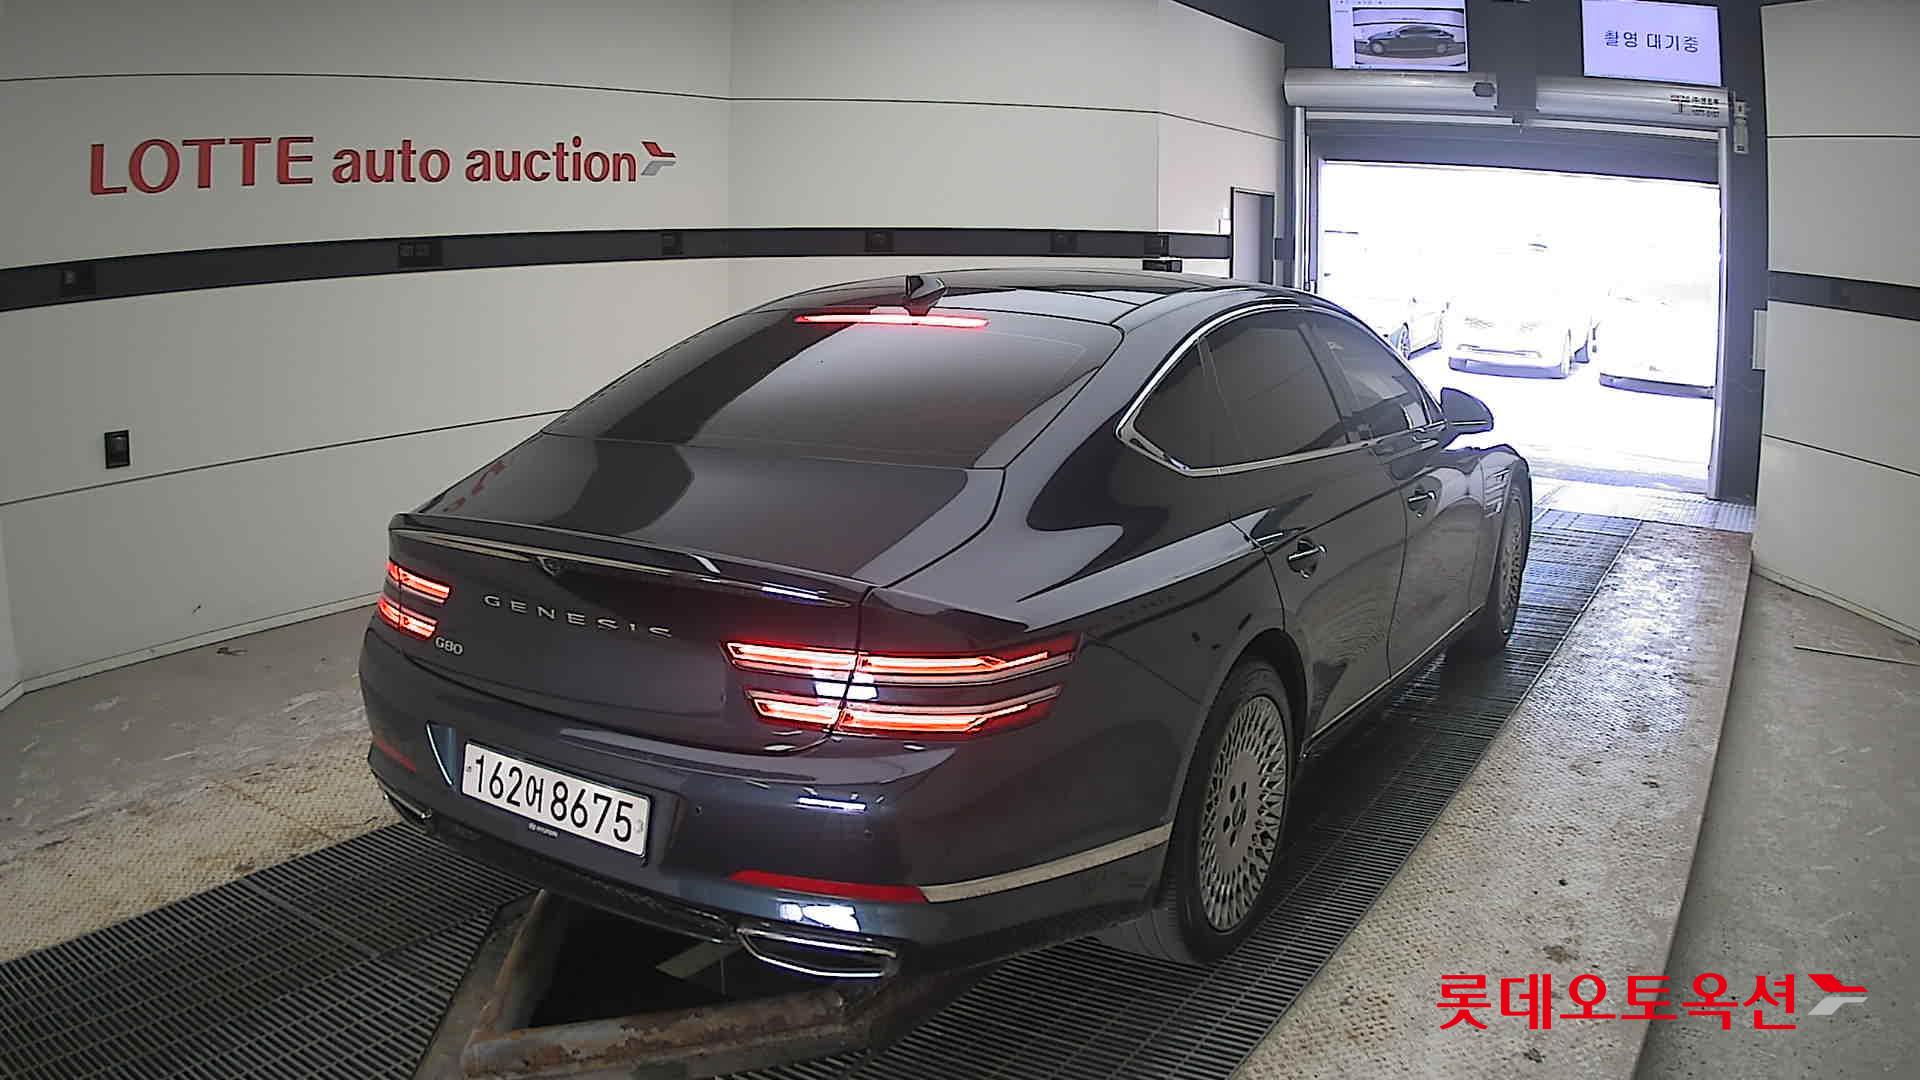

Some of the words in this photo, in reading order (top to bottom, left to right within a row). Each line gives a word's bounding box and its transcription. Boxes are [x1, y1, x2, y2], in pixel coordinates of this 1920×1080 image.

[1604, 30, 1638, 48] 촬영
[1646, 33, 1698, 53] 대기중
[90, 136, 314, 195] LOTTE
[332, 139, 450, 184] auto
[464, 136, 637, 183] auction
[484, 594, 672, 637] GENESIS
[435, 636, 464, 655] G80
